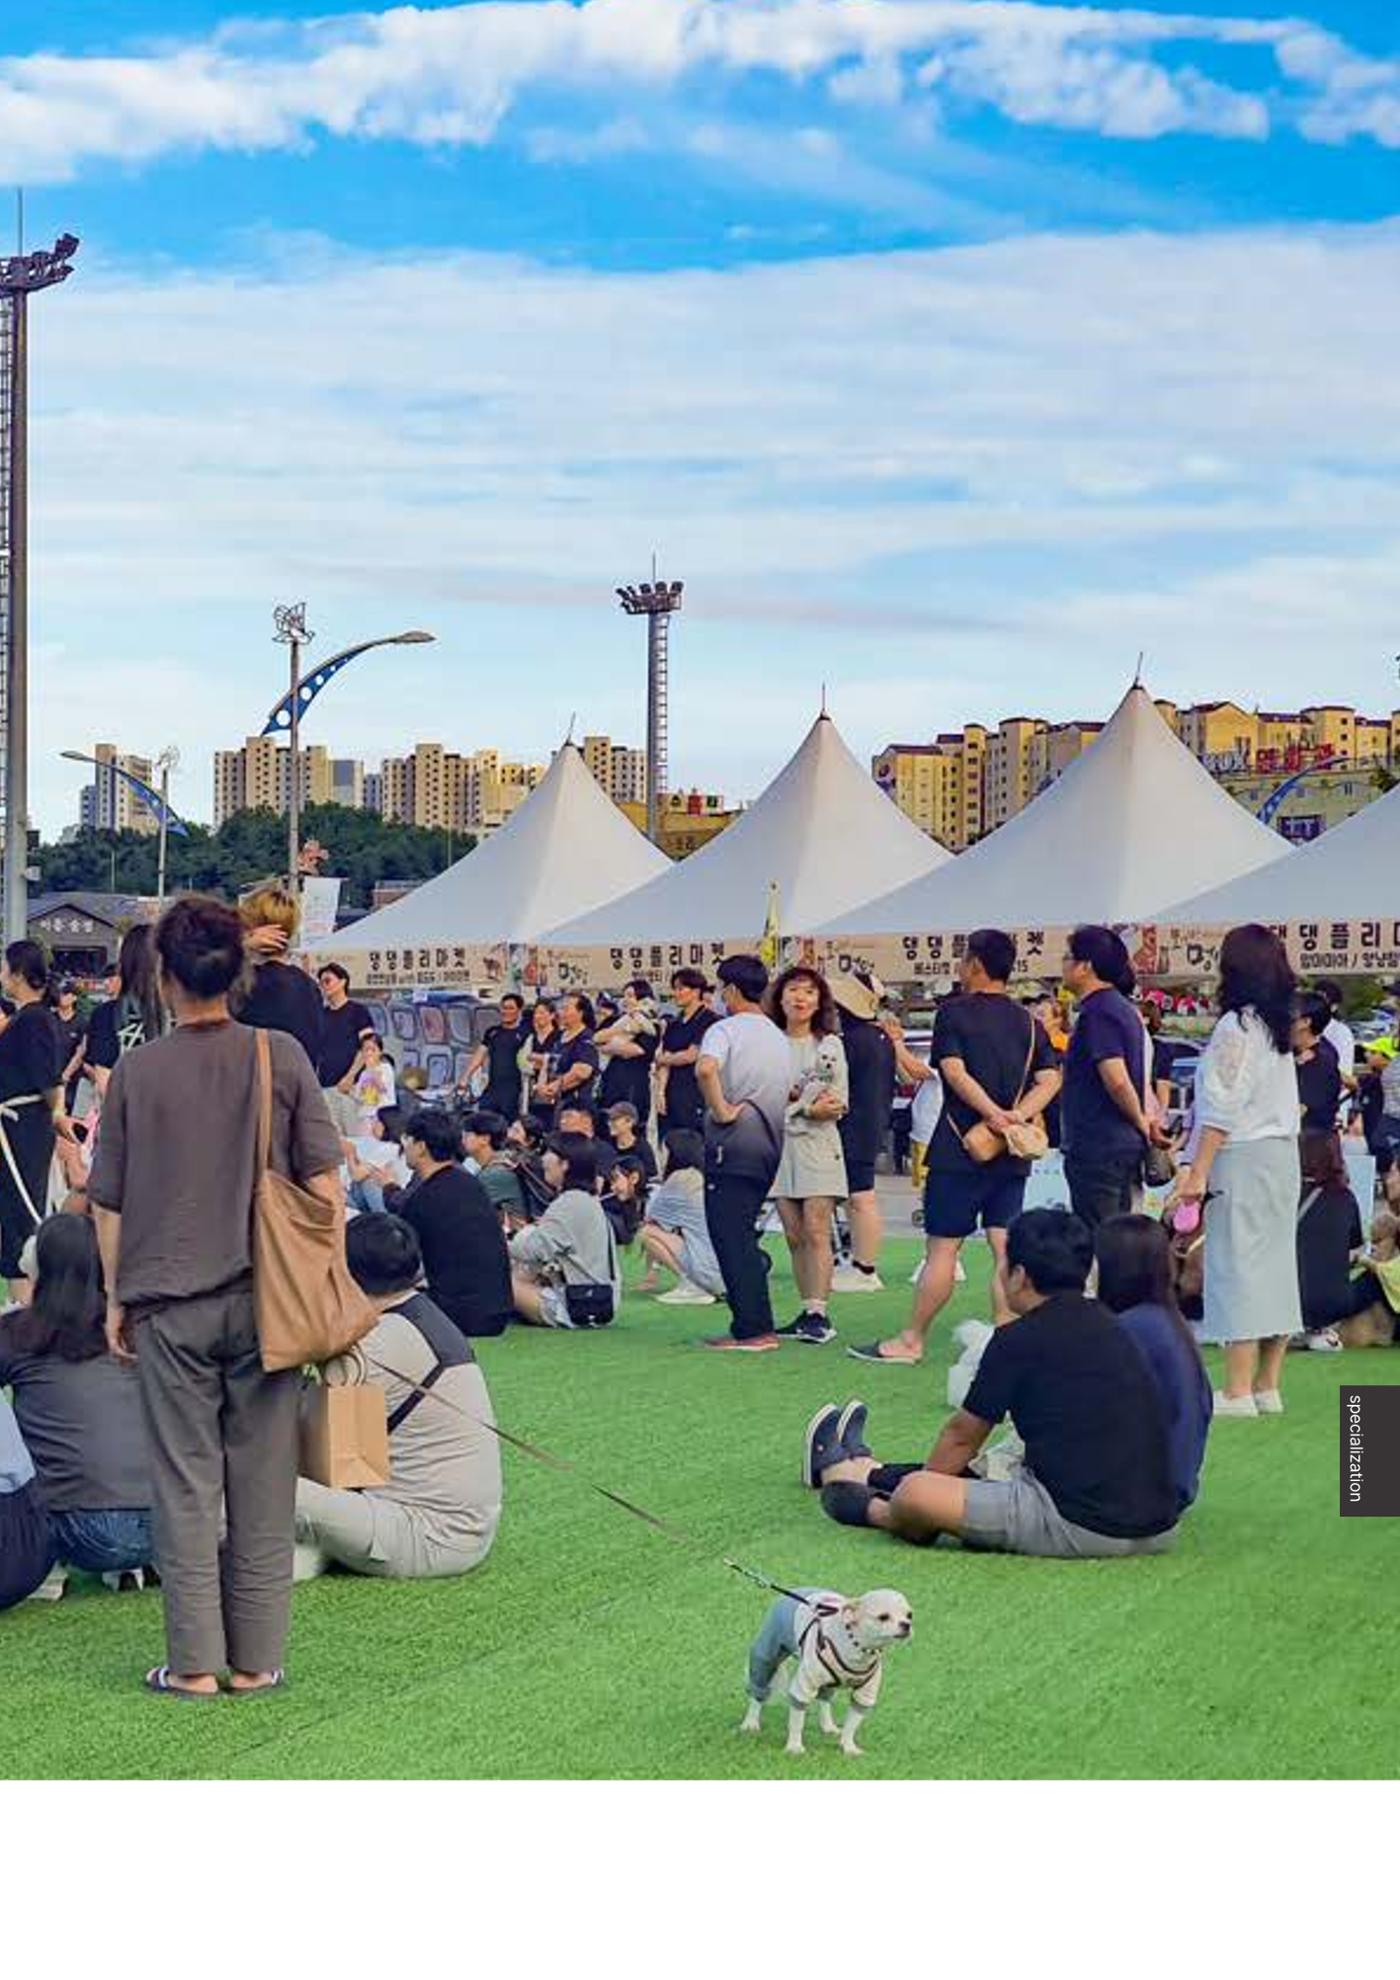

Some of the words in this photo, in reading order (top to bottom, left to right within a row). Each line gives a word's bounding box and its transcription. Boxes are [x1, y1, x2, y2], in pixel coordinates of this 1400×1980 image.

[369, 947, 465, 971] 댕댕플리마켓
[610, 942, 725, 970] 댕댕플리마켓
[902, 931, 1045, 961] 댕댕플켓
